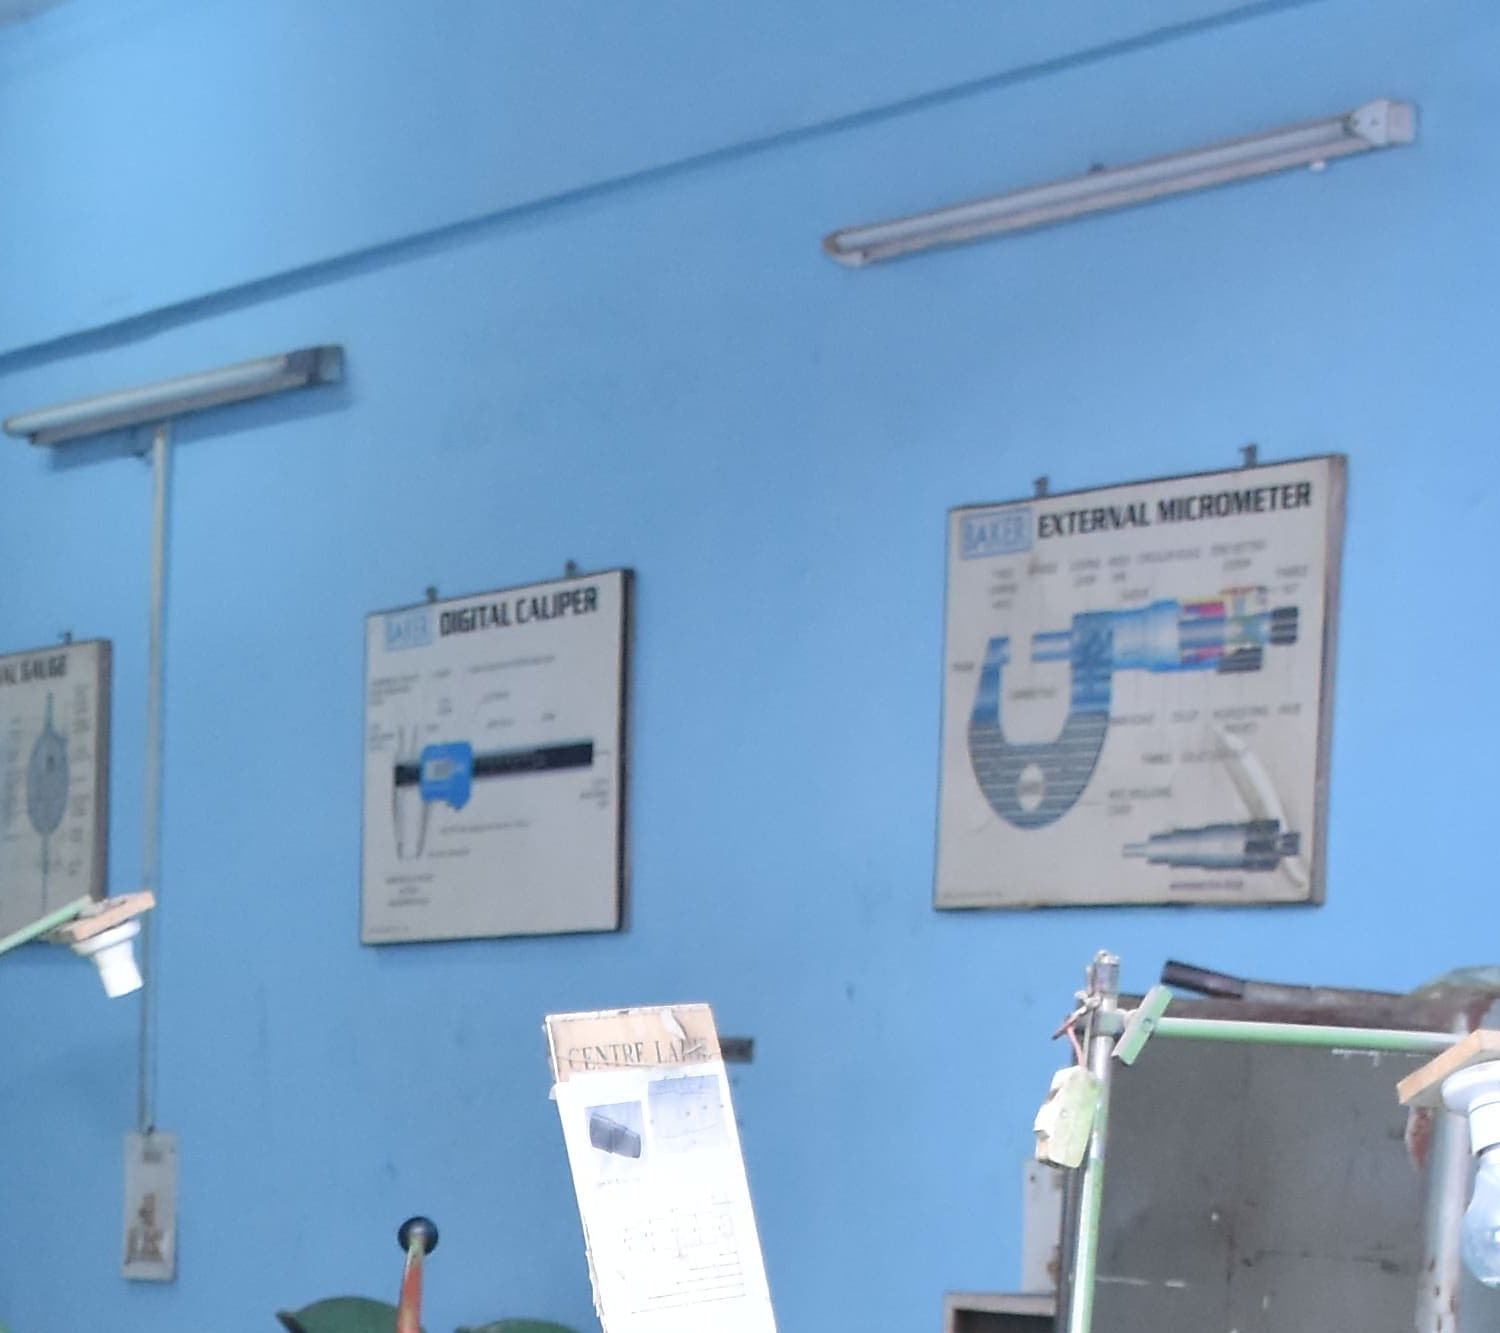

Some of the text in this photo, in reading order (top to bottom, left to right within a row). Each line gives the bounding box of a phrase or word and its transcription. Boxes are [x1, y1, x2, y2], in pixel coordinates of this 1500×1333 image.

[1037, 482, 1312, 539] EXTERNAL MICROMETER
[963, 515, 1026, 550] BAKER
[439, 586, 598, 637] DIGITAL CALIPER
[567, 1041, 644, 1071] CENTRE
